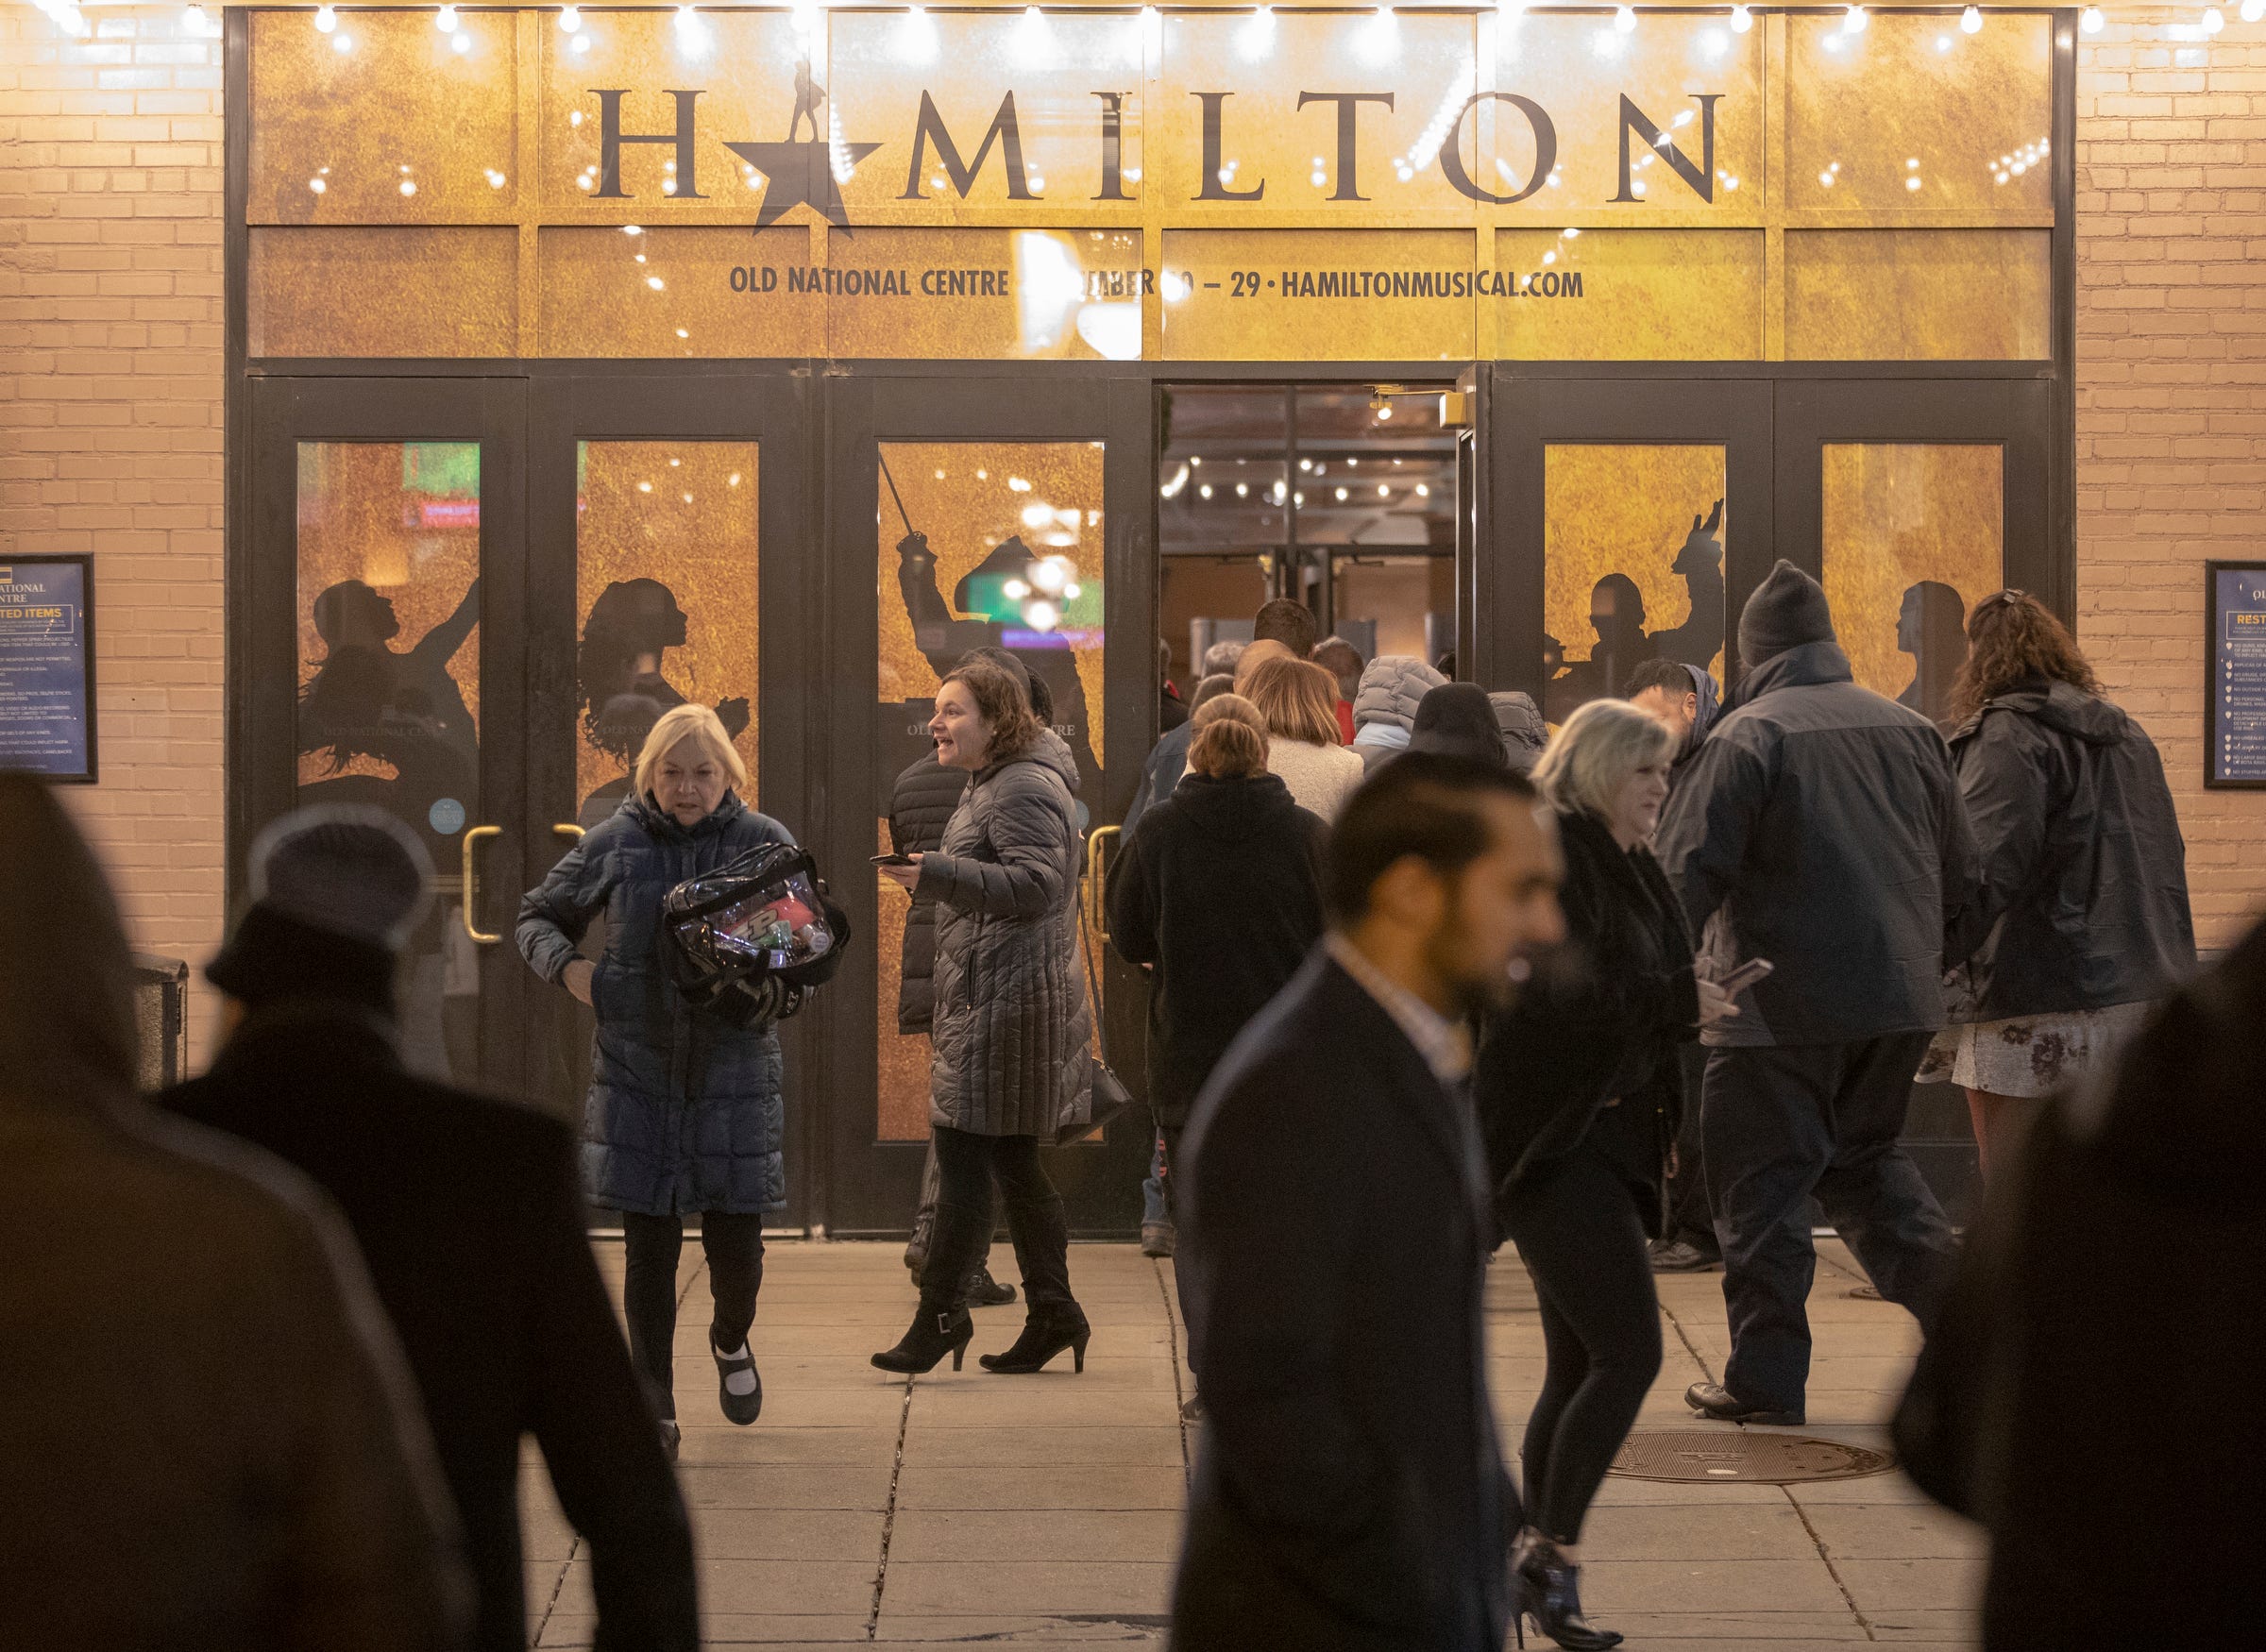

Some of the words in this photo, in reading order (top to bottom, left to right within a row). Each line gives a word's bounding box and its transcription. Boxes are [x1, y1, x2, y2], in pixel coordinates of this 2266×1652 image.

[729, 266, 777, 293] OLD
[788, 266, 911, 295] NATIONAL
[921, 270, 1008, 295] CENTRE
[25, 608, 62, 618] ITEMS
